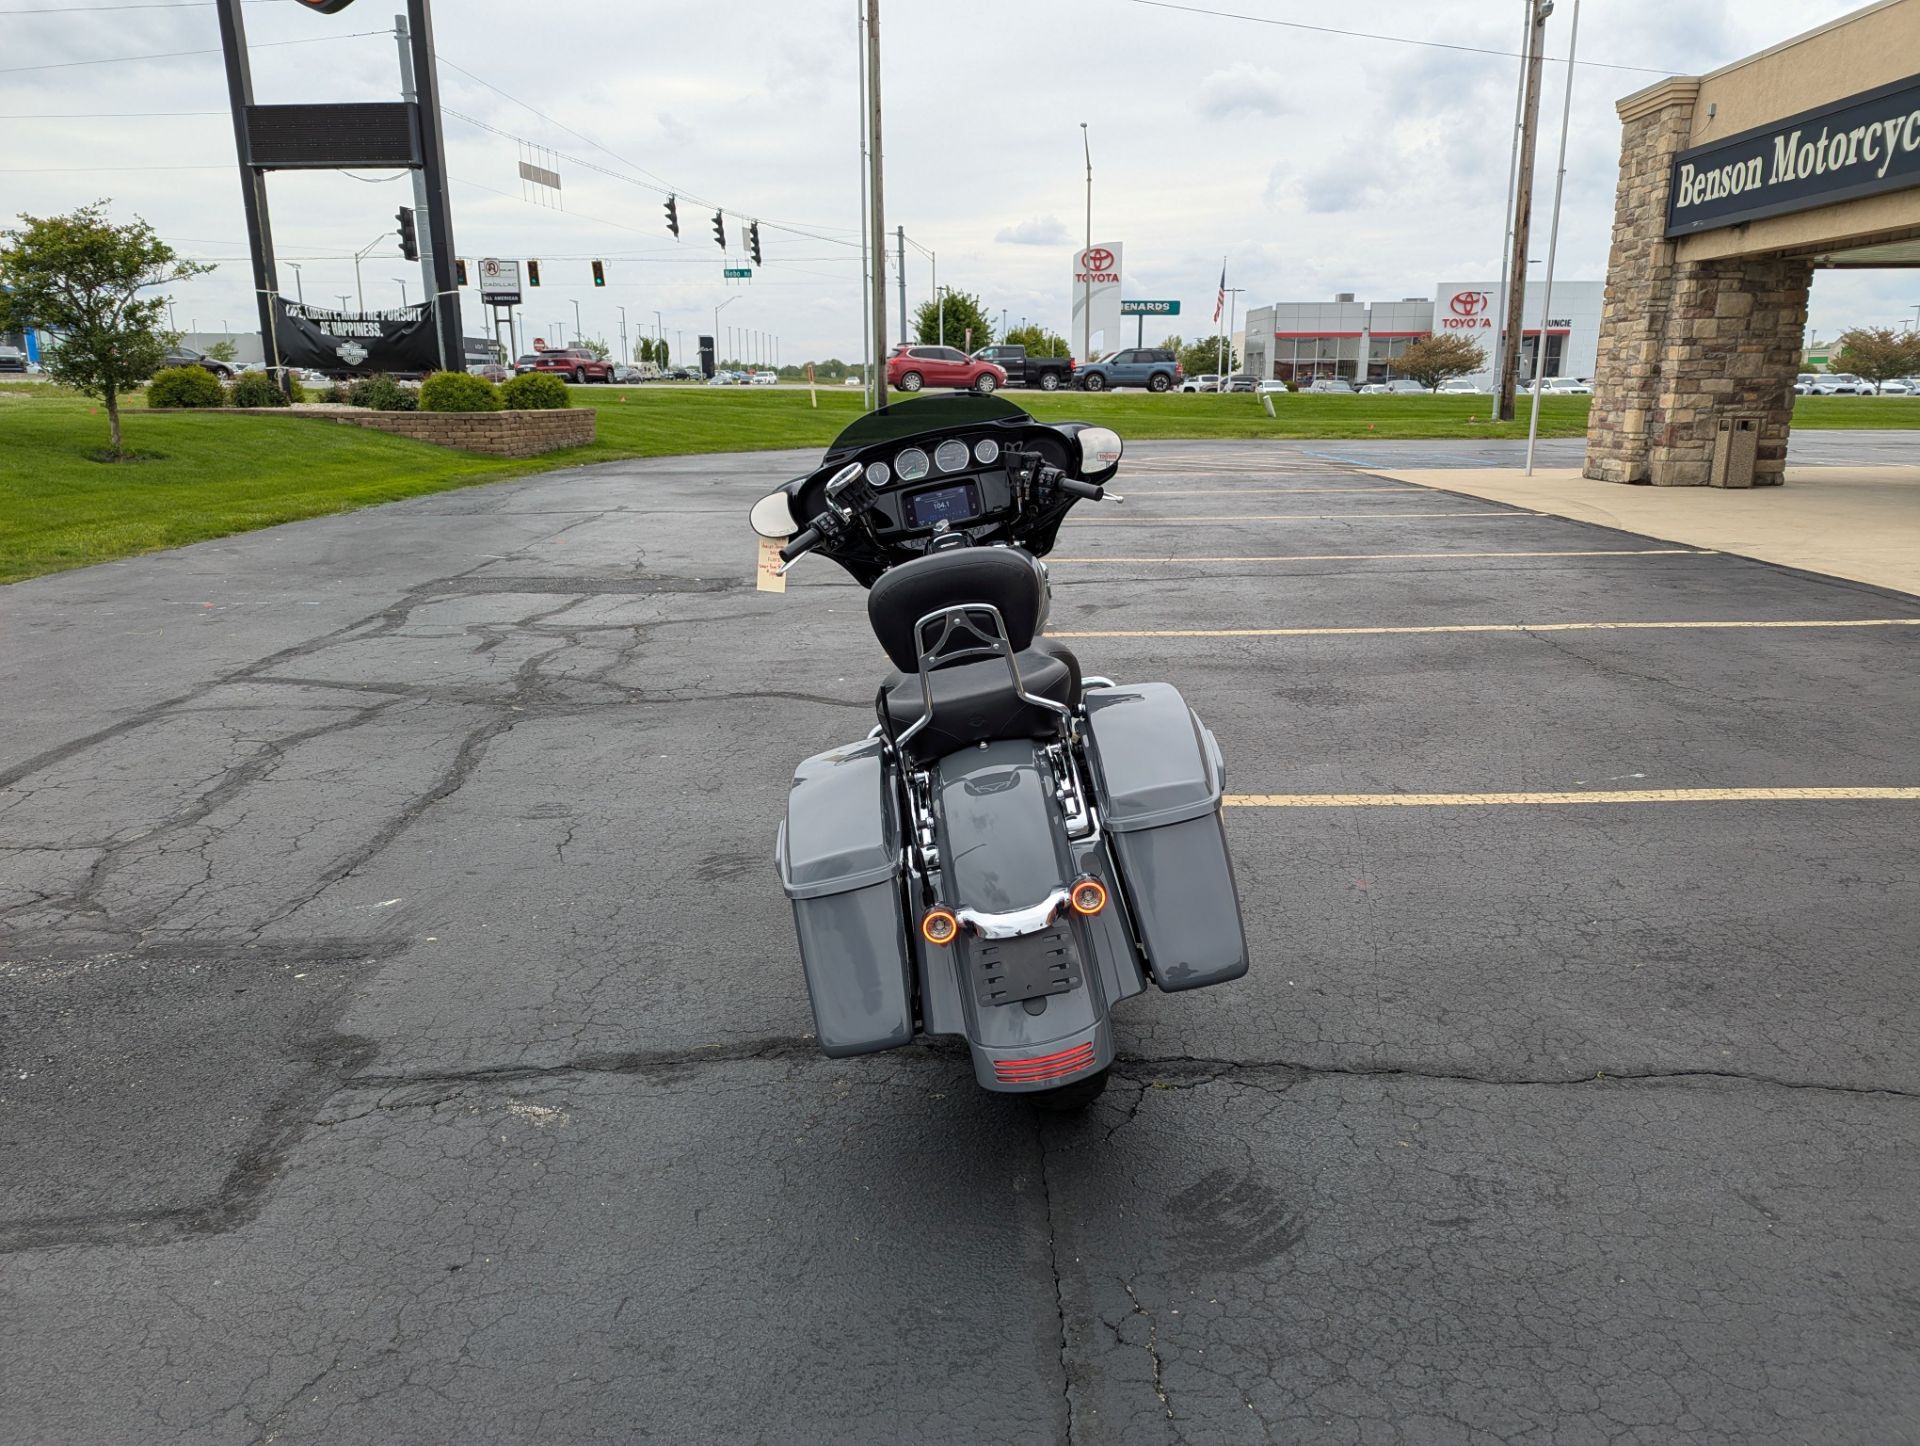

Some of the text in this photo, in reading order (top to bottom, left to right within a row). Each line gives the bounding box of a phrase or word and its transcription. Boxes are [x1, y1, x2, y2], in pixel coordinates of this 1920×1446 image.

[1676, 155, 1763, 208] Benson
[1075, 273, 1119, 283] TOYOTA
[362, 310, 381, 321] THE
[381, 308, 423, 321] PURSUIT
[321, 322, 383, 337] OF HAPPINESS.
